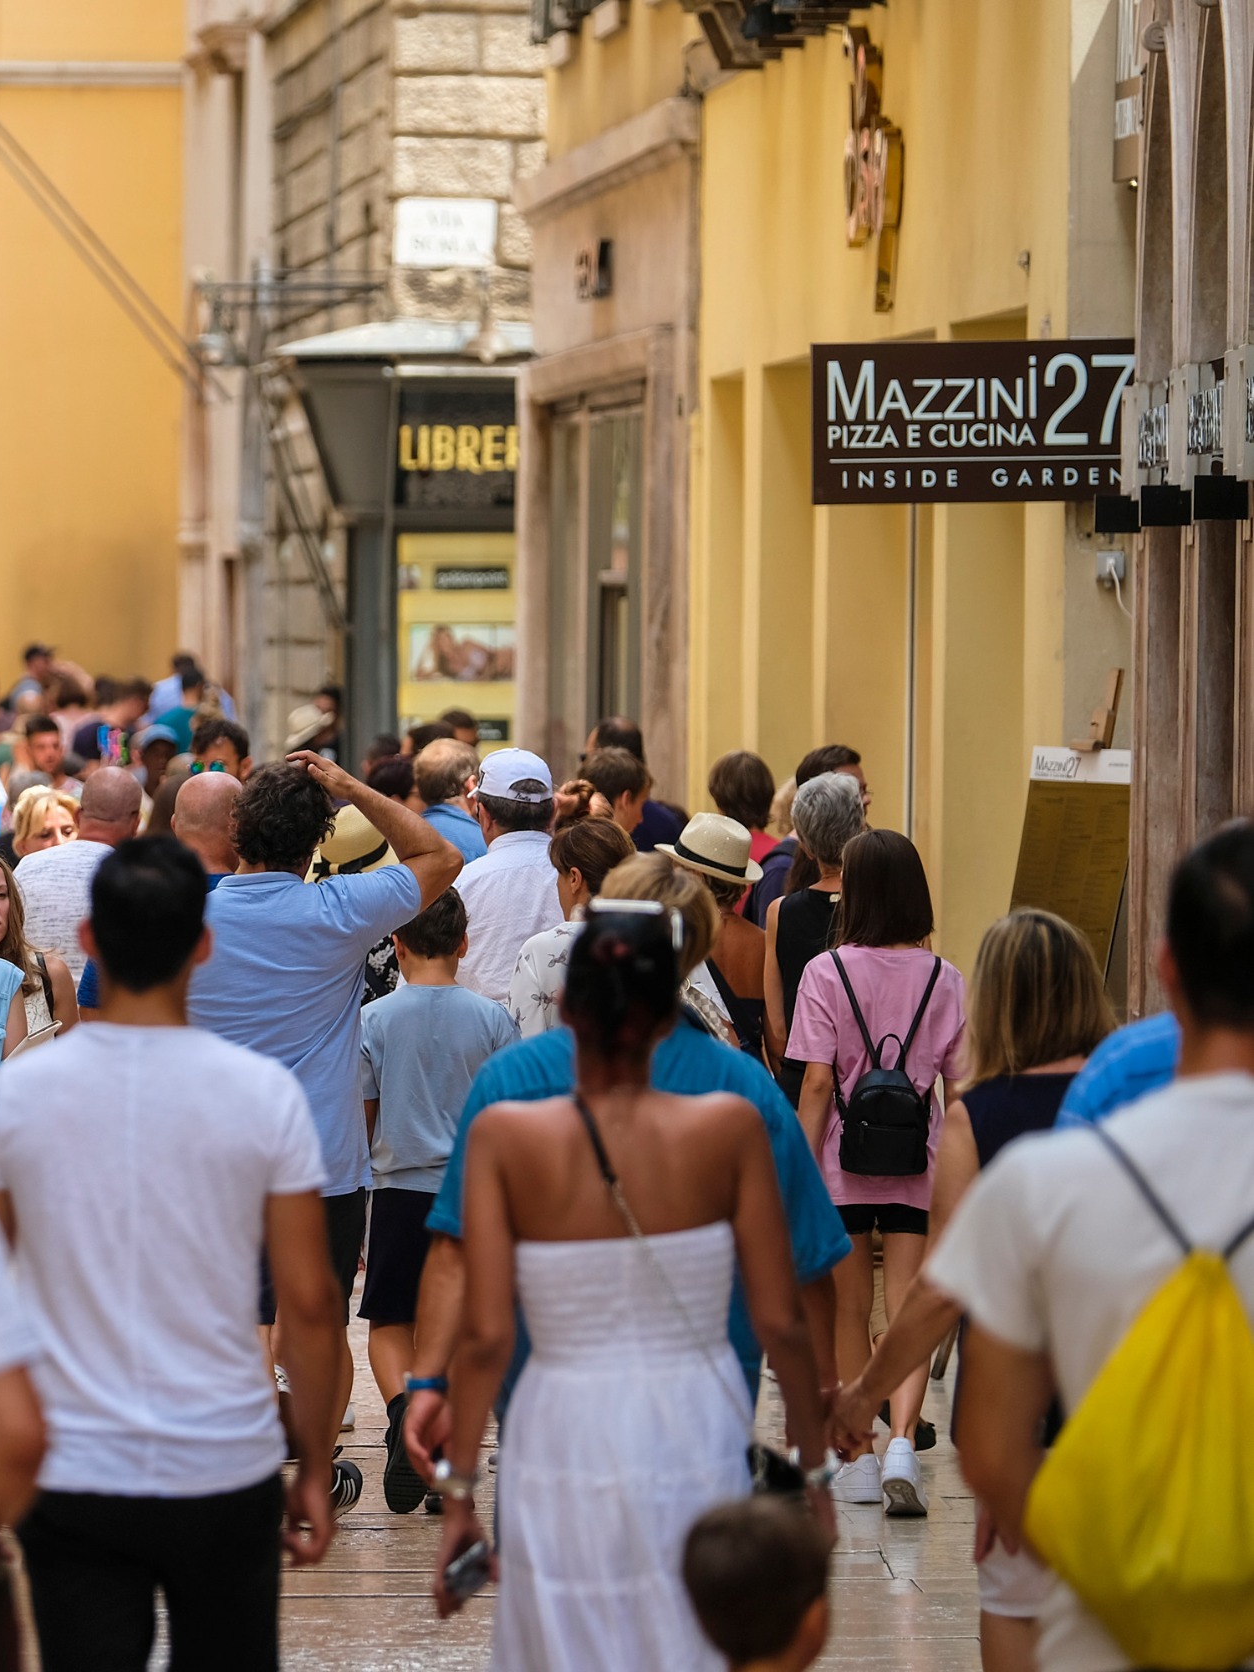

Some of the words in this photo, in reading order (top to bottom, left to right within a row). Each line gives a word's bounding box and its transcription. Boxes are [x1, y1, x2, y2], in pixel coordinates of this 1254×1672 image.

[827, 425, 899, 449] PIZZA
[907, 424, 921, 448] E
[928, 422, 1037, 448] CUCINA
[842, 469, 959, 489] INSIDE
[991, 466, 1122, 488] GARDEN
